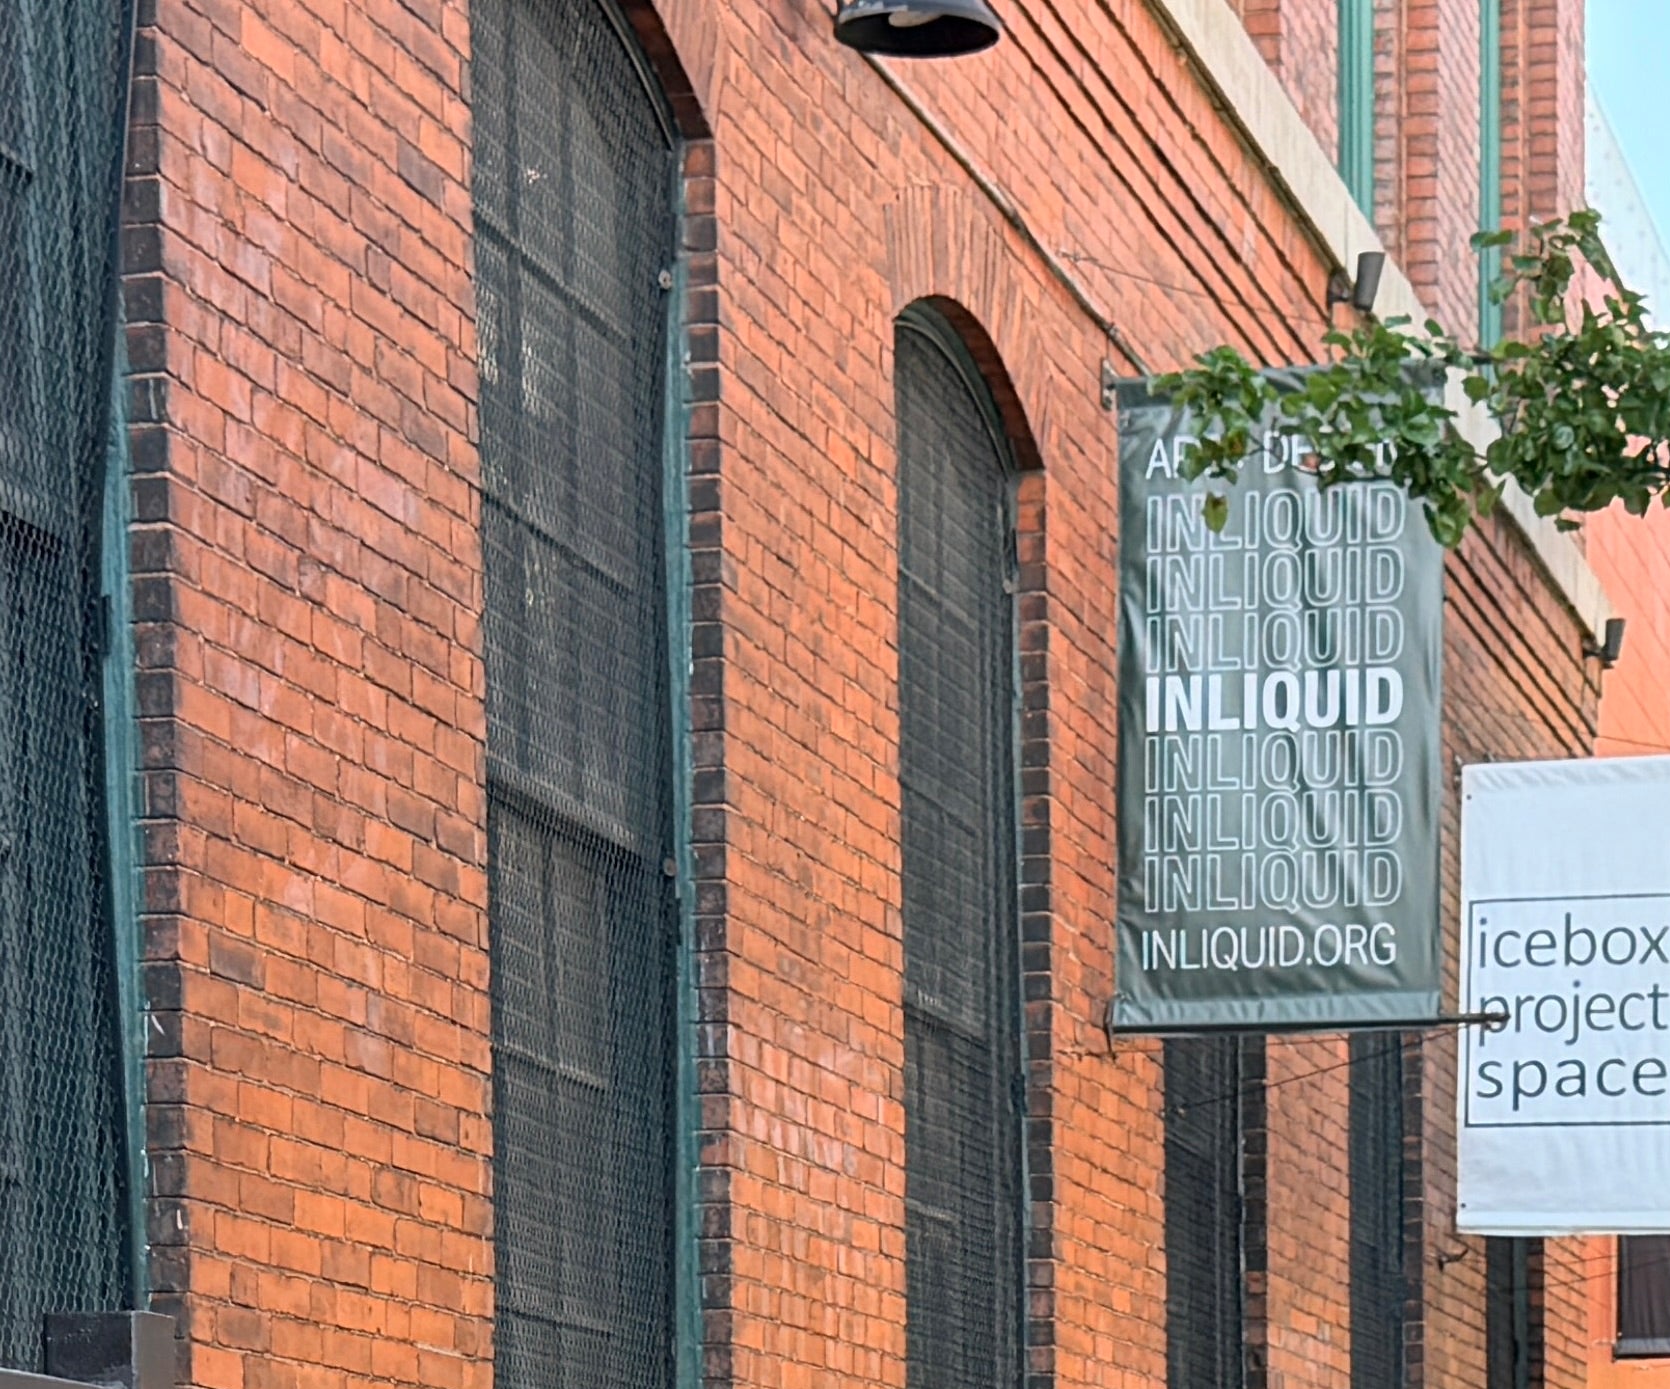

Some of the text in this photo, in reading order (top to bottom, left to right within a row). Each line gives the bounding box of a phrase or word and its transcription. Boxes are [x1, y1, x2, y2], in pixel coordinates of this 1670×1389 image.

[1146, 483, 1406, 554] INLIQUID
[1146, 545, 1405, 613] INLIQUID
[1146, 606, 1404, 674] INLIQUID
[1145, 666, 1403, 733] INLIQUID
[1144, 728, 1403, 793] INLIQUID
[1144, 788, 1402, 853] INLIQUID
[1144, 849, 1402, 914] INLIQUID
[1142, 922, 1397, 971] INLIQUID.ORG
[1479, 912, 1669, 969] icebox
[1478, 980, 1669, 1047] project
[1475, 1056, 1667, 1112] space
